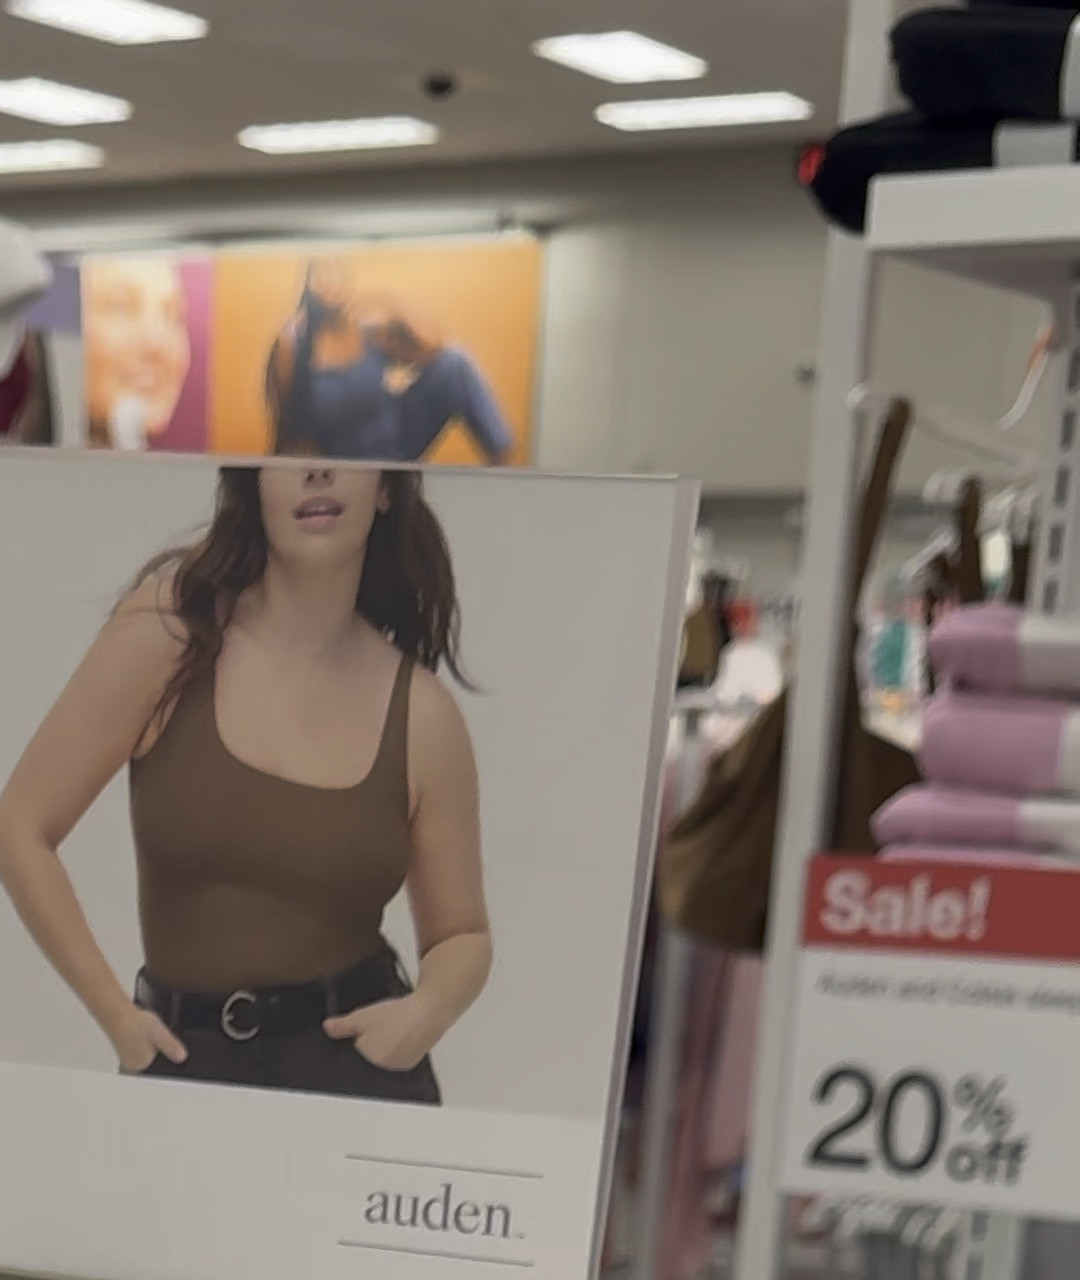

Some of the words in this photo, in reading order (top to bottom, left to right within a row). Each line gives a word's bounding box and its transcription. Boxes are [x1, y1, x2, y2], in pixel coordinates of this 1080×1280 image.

[820, 869, 992, 941] Sale!
[945, 1136, 1029, 1186] off
[364, 1183, 512, 1239] auden
